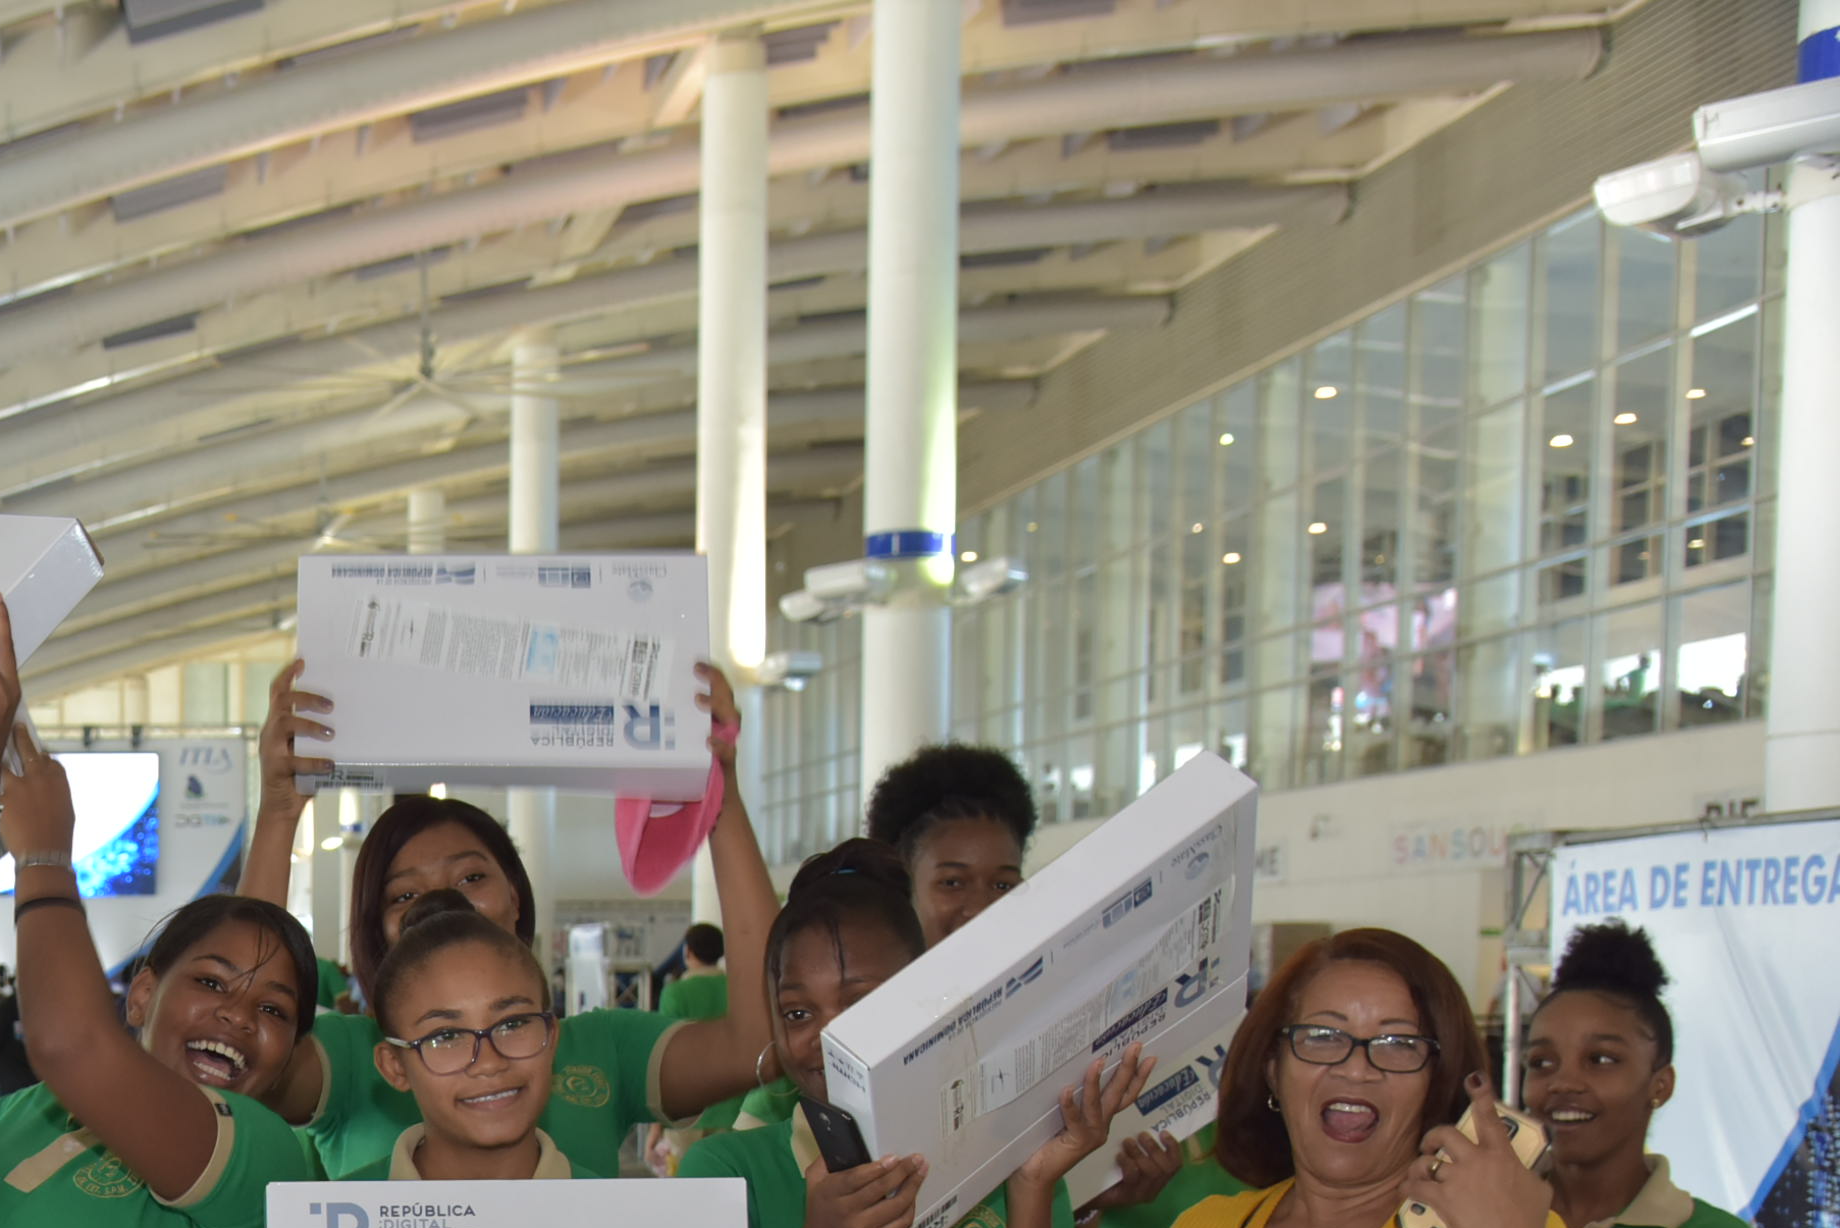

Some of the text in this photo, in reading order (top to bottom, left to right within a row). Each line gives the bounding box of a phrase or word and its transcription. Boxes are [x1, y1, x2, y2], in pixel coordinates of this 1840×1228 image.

[530, 735, 615, 749] REPÚBLICA
[1563, 861, 1639, 917] ÁREA
[1650, 863, 1690, 909] DE
[958, 986, 1002, 1026] REPÚBLICA
[903, 1019, 958, 1066] DOMINICANA
[1151, 1090, 1211, 1132] REPÚBLICA
[379, 1202, 476, 1217] REPÚBLICA
